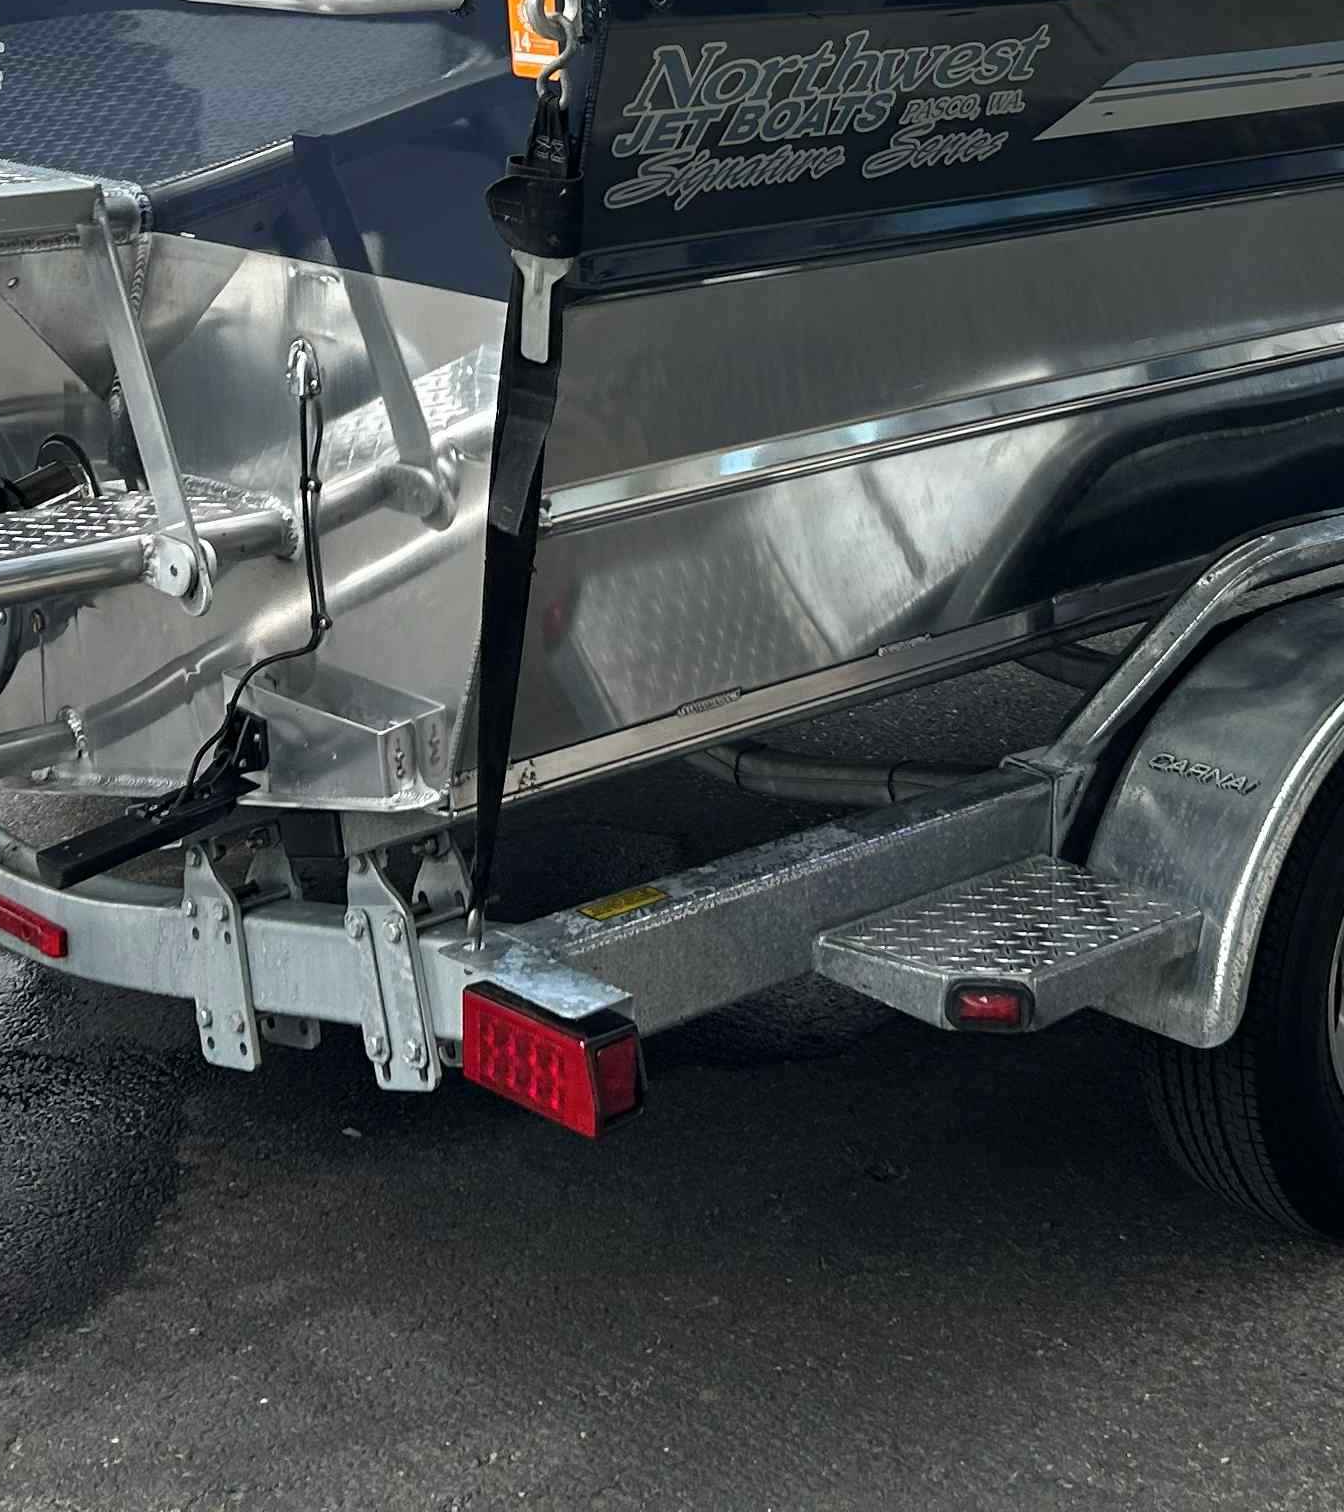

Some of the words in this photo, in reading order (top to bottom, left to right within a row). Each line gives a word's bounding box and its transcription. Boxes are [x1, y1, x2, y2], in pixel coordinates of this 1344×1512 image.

[514, 29, 532, 53] 14
[622, 24, 1051, 117] Northwest
[611, 105, 728, 158] JET
[717, 90, 897, 146] BOATS
[898, 93, 982, 125] PASCO,
[604, 144, 846, 211] Signature
[862, 121, 1009, 179] Series
